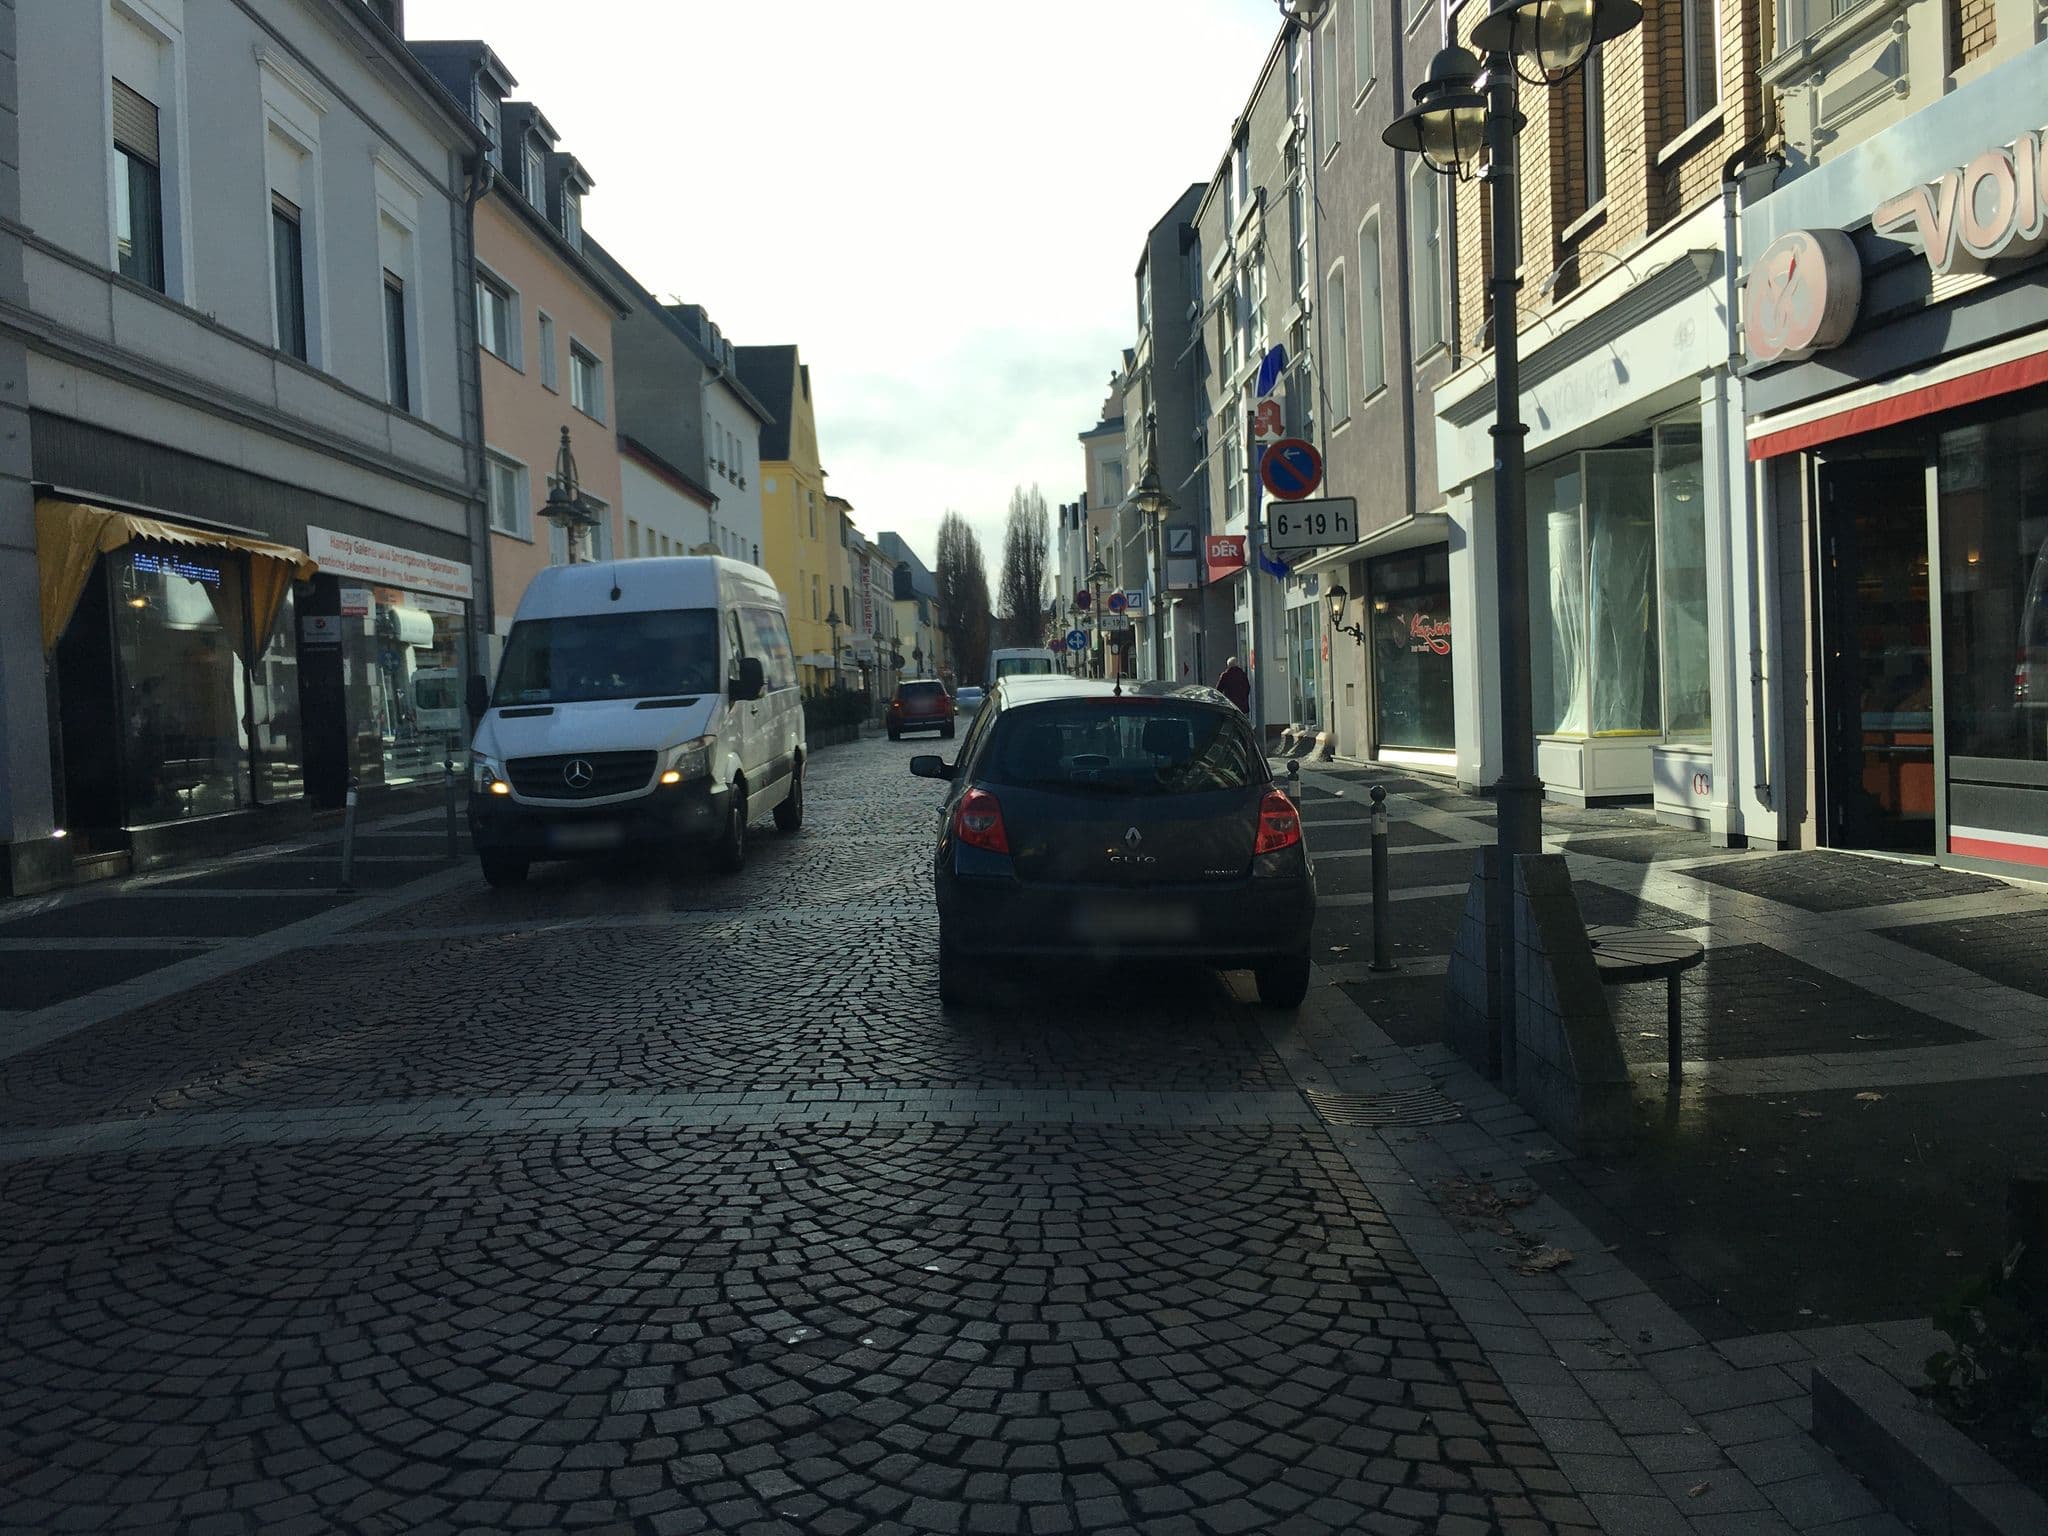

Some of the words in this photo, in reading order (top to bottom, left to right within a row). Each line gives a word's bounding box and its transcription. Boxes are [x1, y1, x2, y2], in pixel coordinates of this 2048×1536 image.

[1872, 128, 2048, 275] VOI
[1335, 512, 1348, 532] h
[1110, 856, 1157, 864] CLIO
